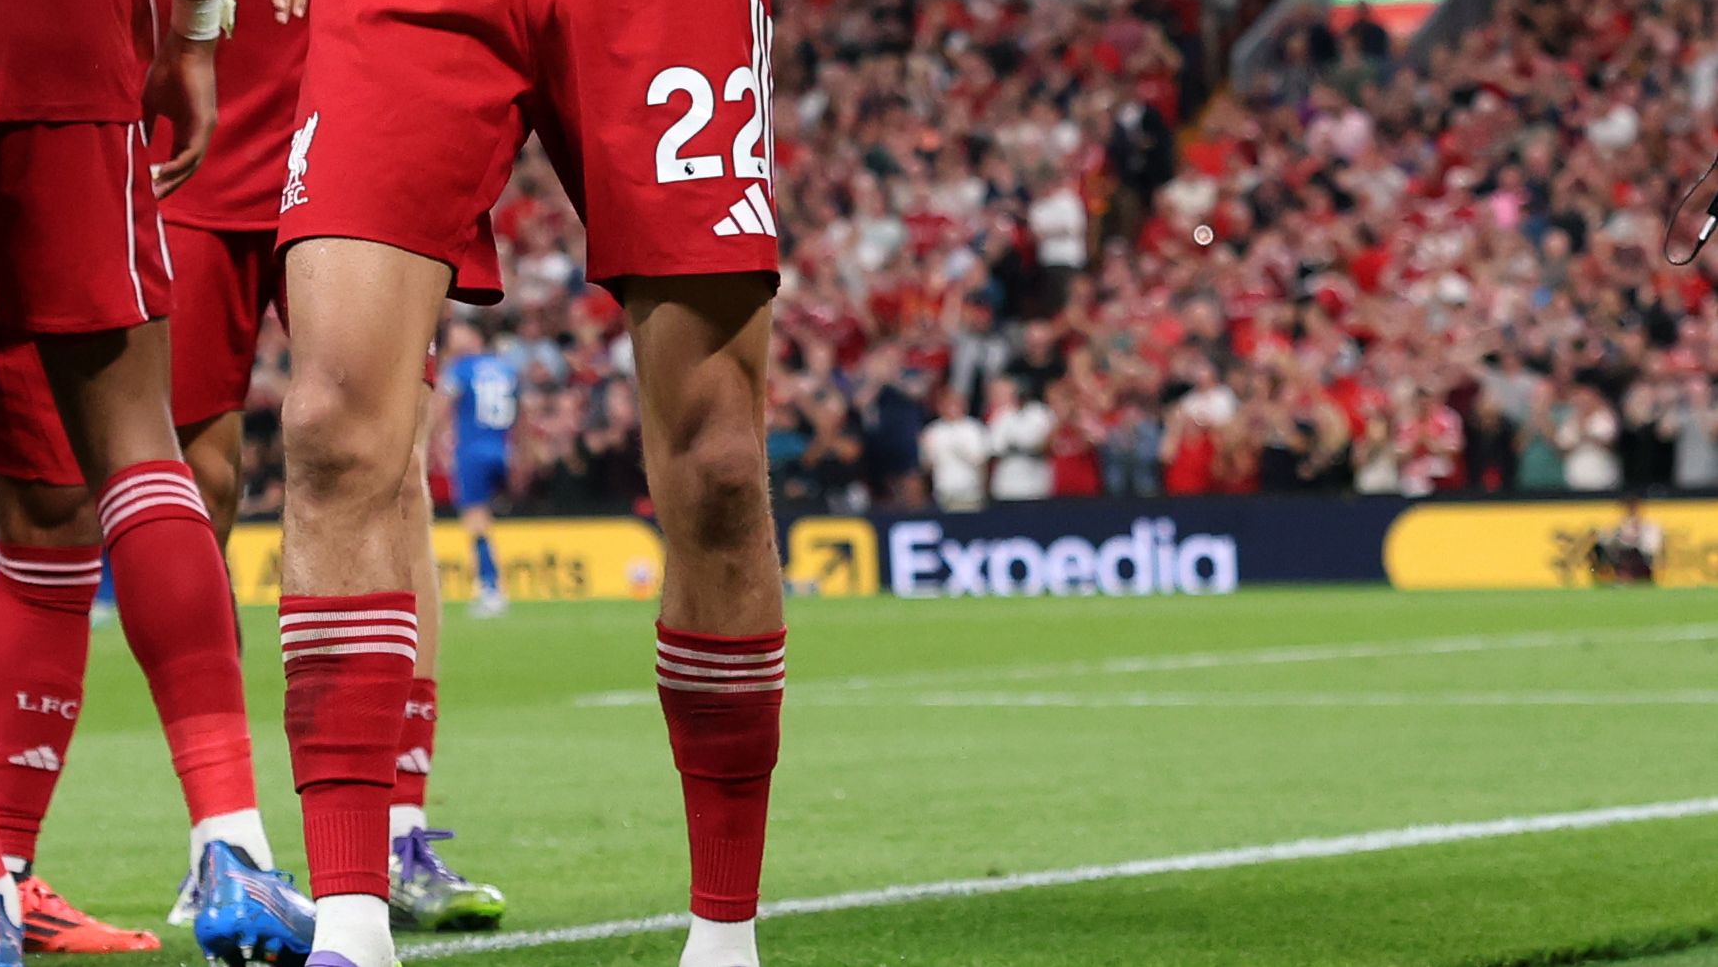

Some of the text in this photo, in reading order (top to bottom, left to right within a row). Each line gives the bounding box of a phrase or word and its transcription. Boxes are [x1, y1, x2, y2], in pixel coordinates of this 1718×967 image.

[646, 66, 768, 184] 22
[888, 517, 1240, 599] Expedia
[17, 690, 79, 720] LFC
[403, 700, 435, 722] FC
